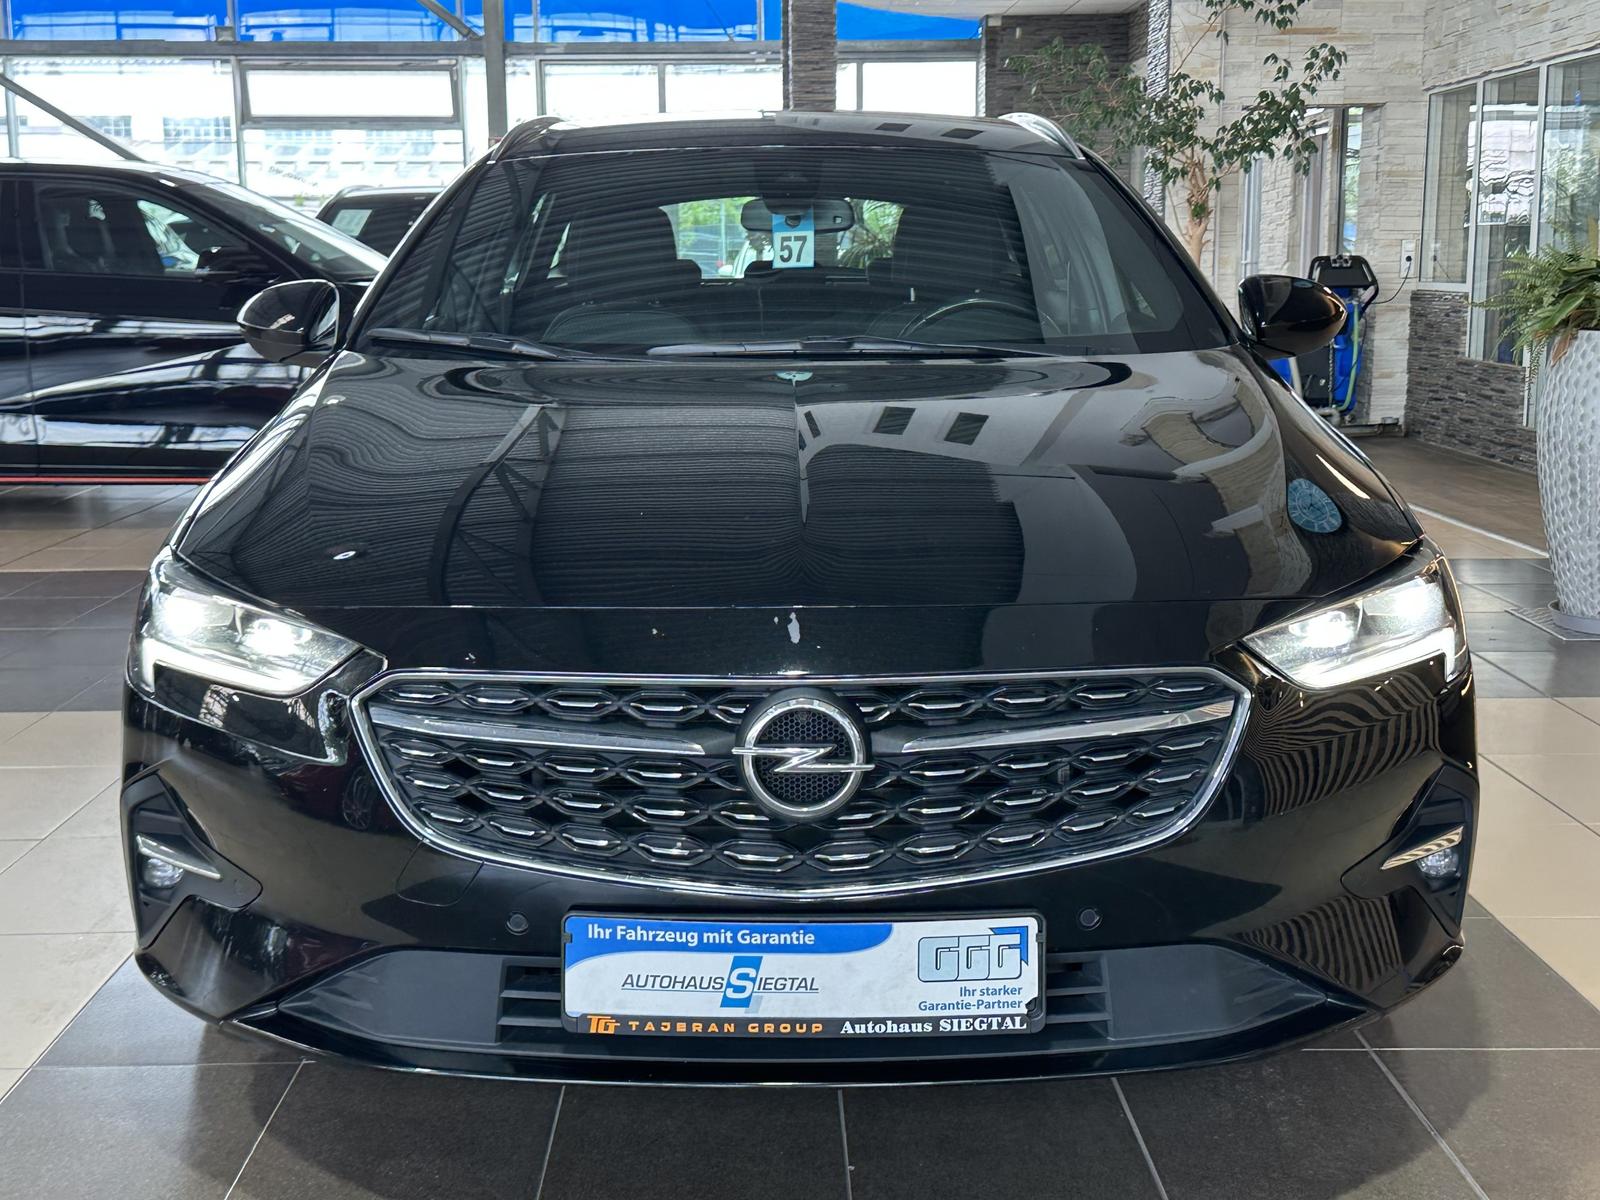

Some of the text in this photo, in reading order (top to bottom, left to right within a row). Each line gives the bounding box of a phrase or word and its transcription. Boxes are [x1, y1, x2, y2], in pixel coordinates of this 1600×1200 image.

[780, 235, 808, 263] 57
[587, 924, 815, 946] Ihr Fahrzeug mit Garantie
[621, 968, 819, 999] AUTOHAUS SIEGTAL
[959, 984, 1023, 997] Ihr starker
[918, 999, 1023, 1011] Garantie-Partner
[628, 1020, 736, 1033] TAJERAN
[747, 1022, 823, 1034] GROUP
[840, 1016, 1027, 1035] Autohaus SIEGTAL
